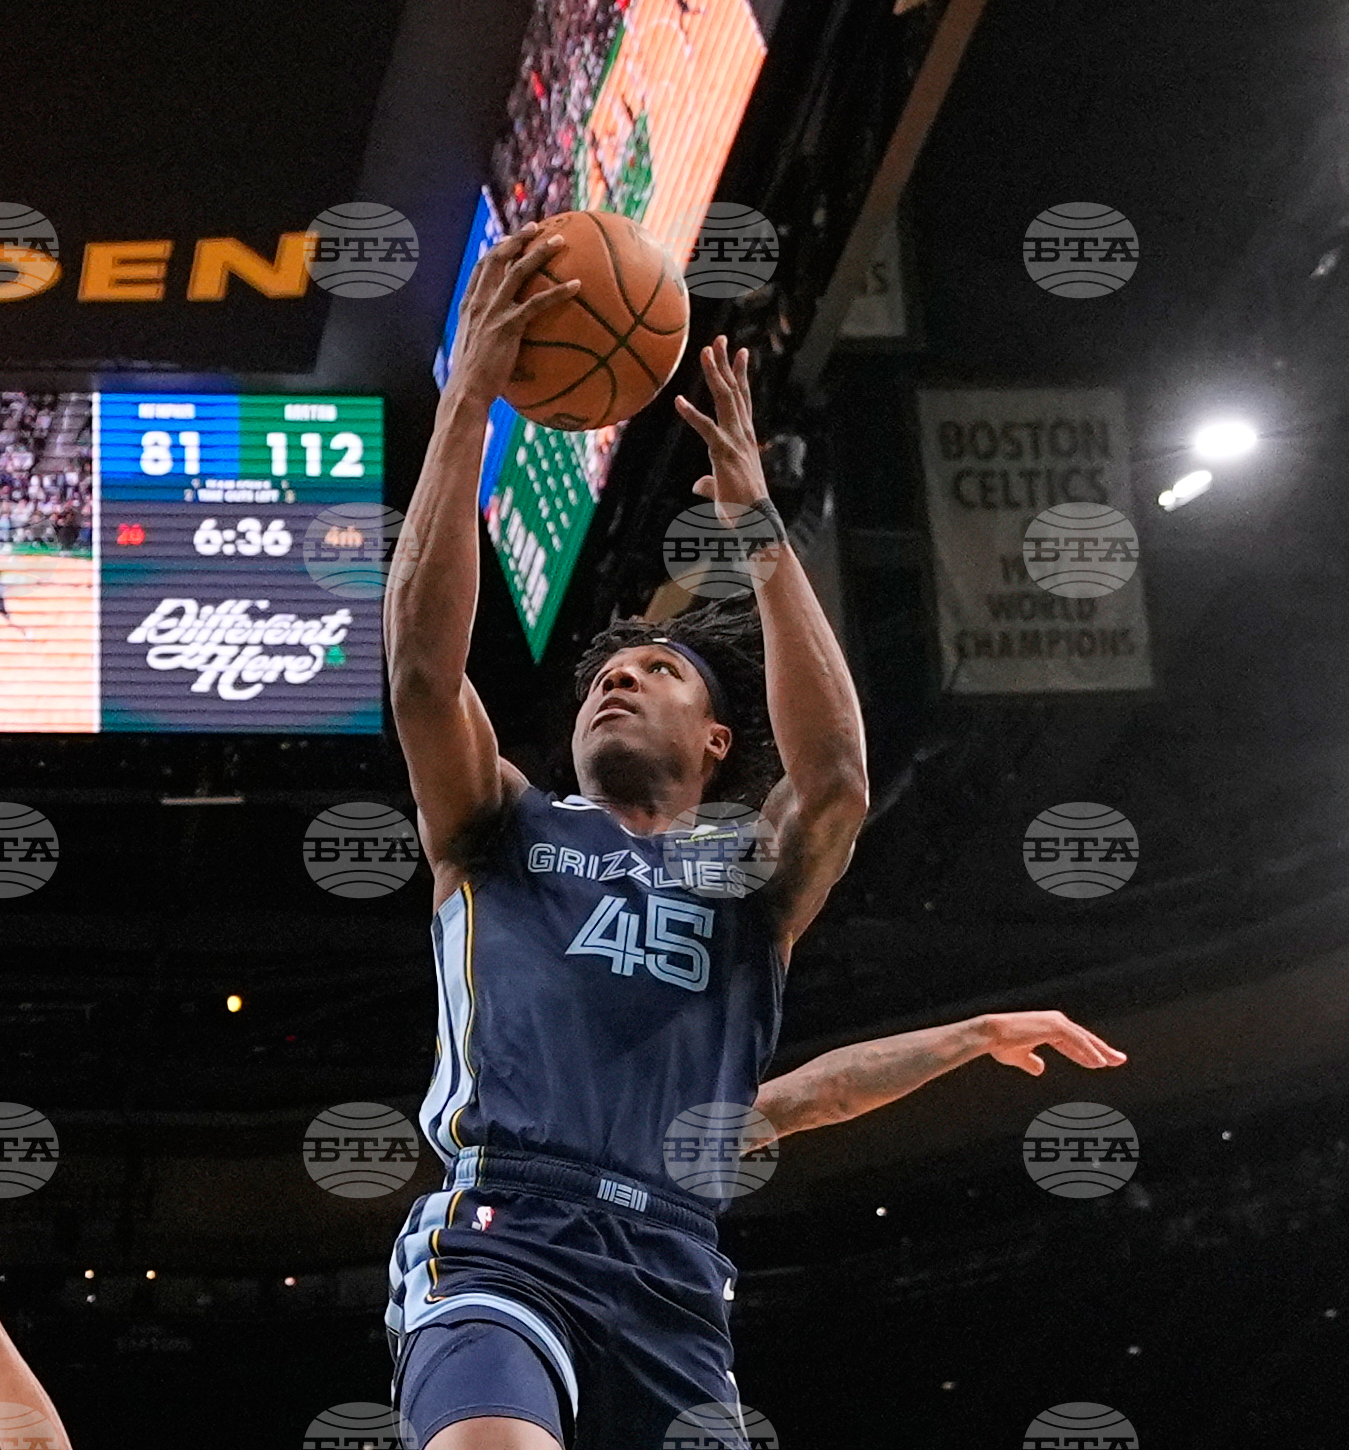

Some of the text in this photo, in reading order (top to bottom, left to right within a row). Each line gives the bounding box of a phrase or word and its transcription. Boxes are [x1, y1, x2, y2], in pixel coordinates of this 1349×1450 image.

[140, 431, 365, 477] 81 112
[937, 421, 1110, 461] BOSTON
[954, 466, 1109, 509] CELTICS
[193, 517, 293, 556] 6:36
[127, 598, 353, 645] Different
[146, 643, 325, 700] Here
[527, 842, 746, 899] GRIZZLIES
[565, 894, 715, 992] 45
